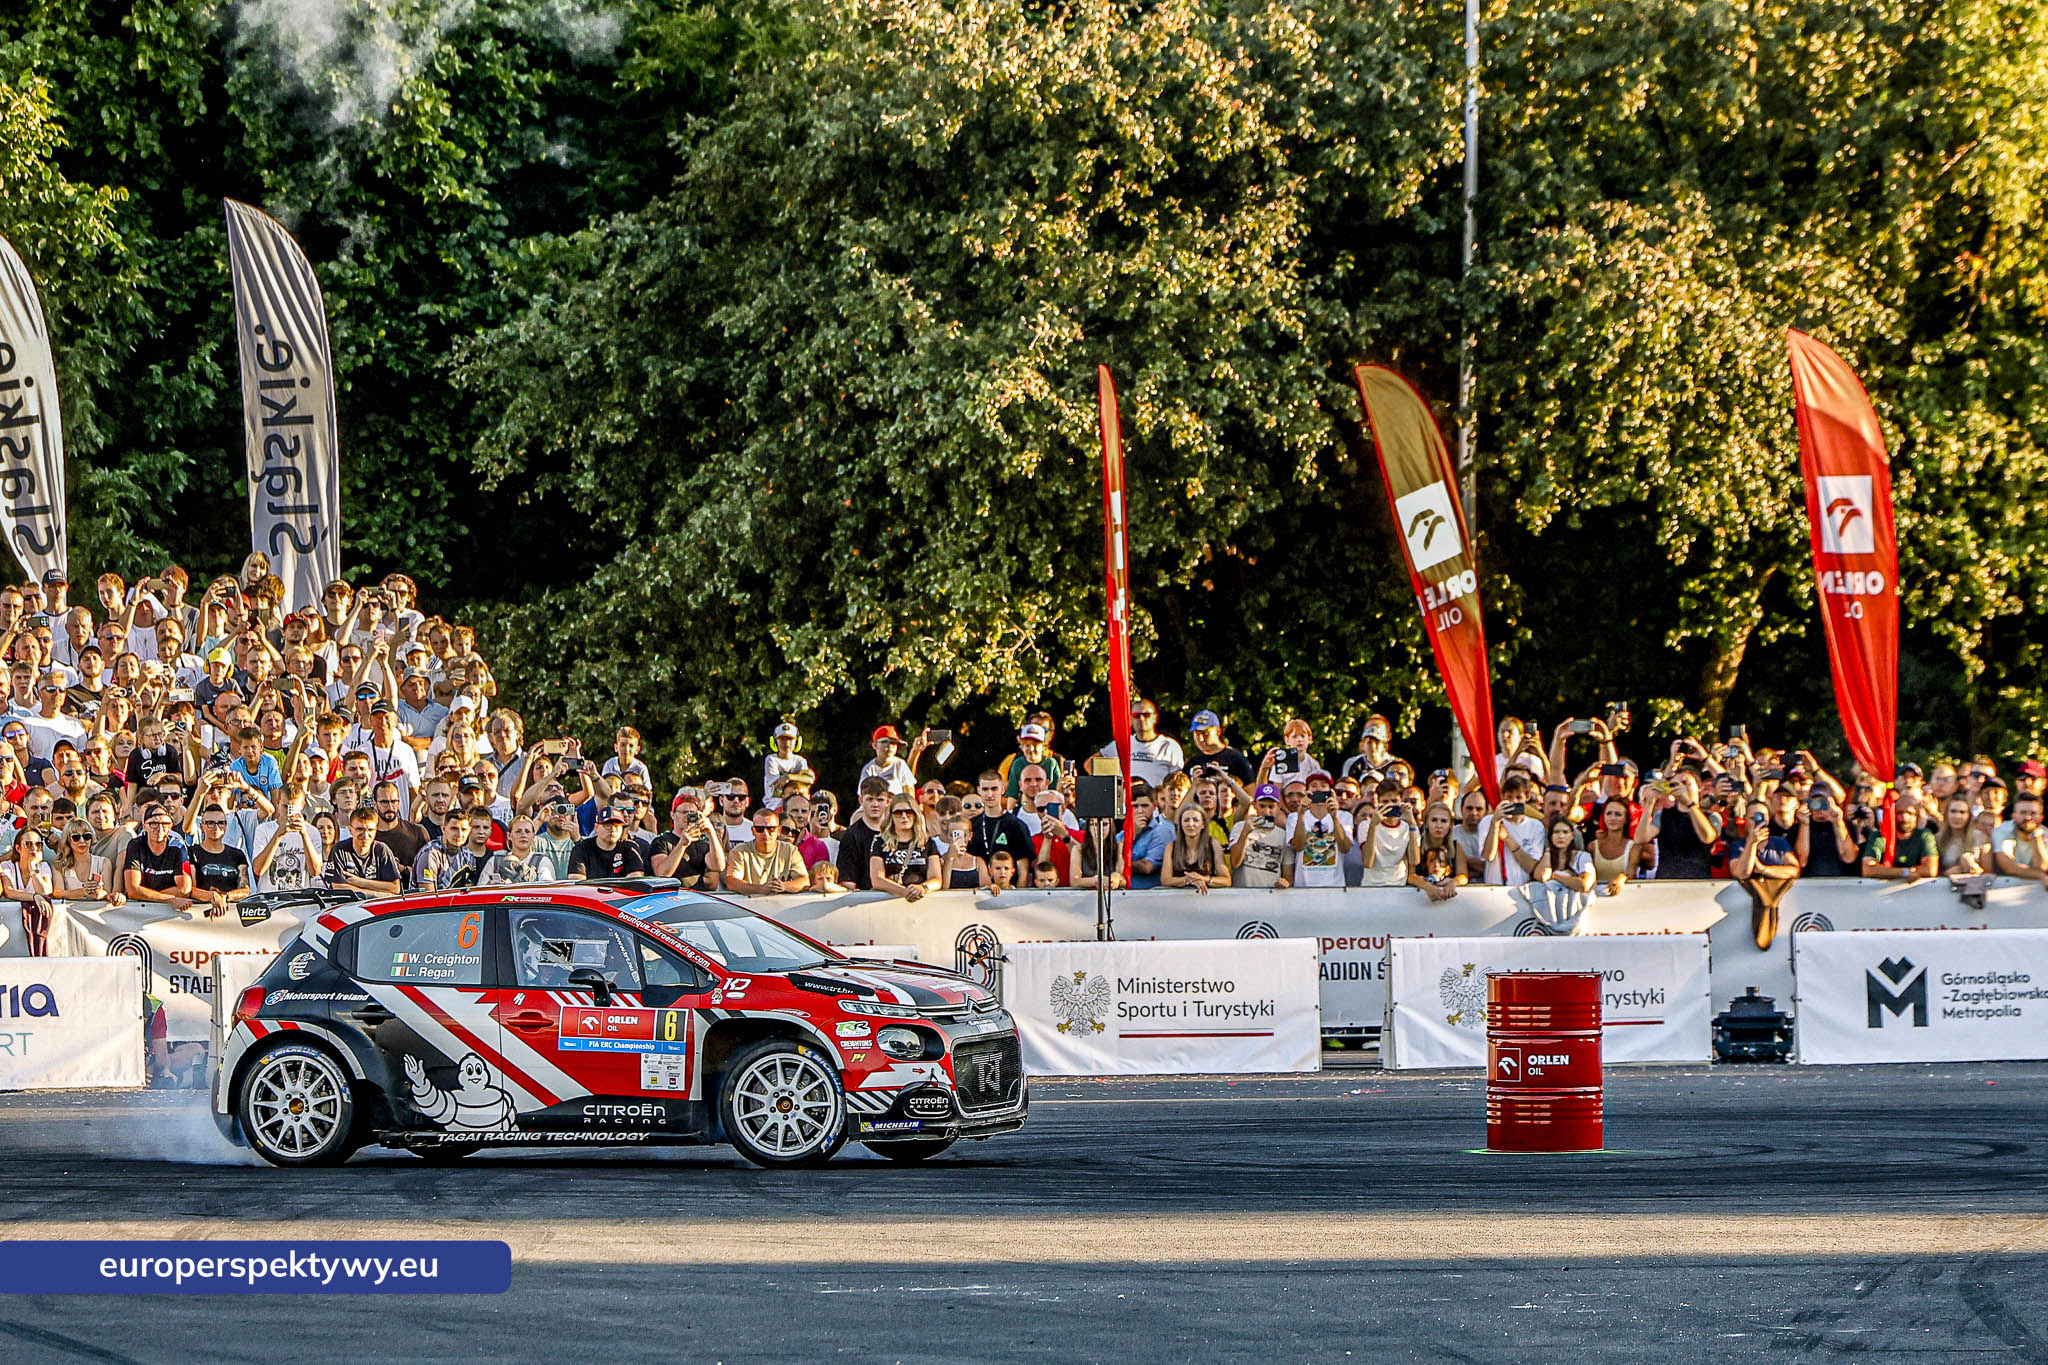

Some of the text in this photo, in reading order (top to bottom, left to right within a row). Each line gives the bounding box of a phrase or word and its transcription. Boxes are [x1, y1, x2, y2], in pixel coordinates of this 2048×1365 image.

[241, 907, 267, 917] Hertz
[457, 912, 481, 949] 6
[617, 911, 711, 968] boutique.citroenracing.com
[408, 953, 480, 967] W. Creighton
[405, 966, 455, 980] L. Regan
[1117, 977, 1235, 994] Ministerstwo
[284, 991, 370, 1001] Motorsport Ireland
[1117, 999, 1275, 1021] Sportu i Turystyki
[1942, 1004, 2022, 1020] Metropolia
[607, 1015, 638, 1025] ORLEN
[664, 1010, 678, 1041] 6
[588, 1040, 656, 1052] FIA ERC Championship
[1527, 1055, 1570, 1066] ORLEN
[1527, 1067, 1545, 1076] OIL
[874, 1121, 920, 1129] MICHELIN
[437, 1131, 649, 1142] TAGAI RACING TECHNOLOGY
